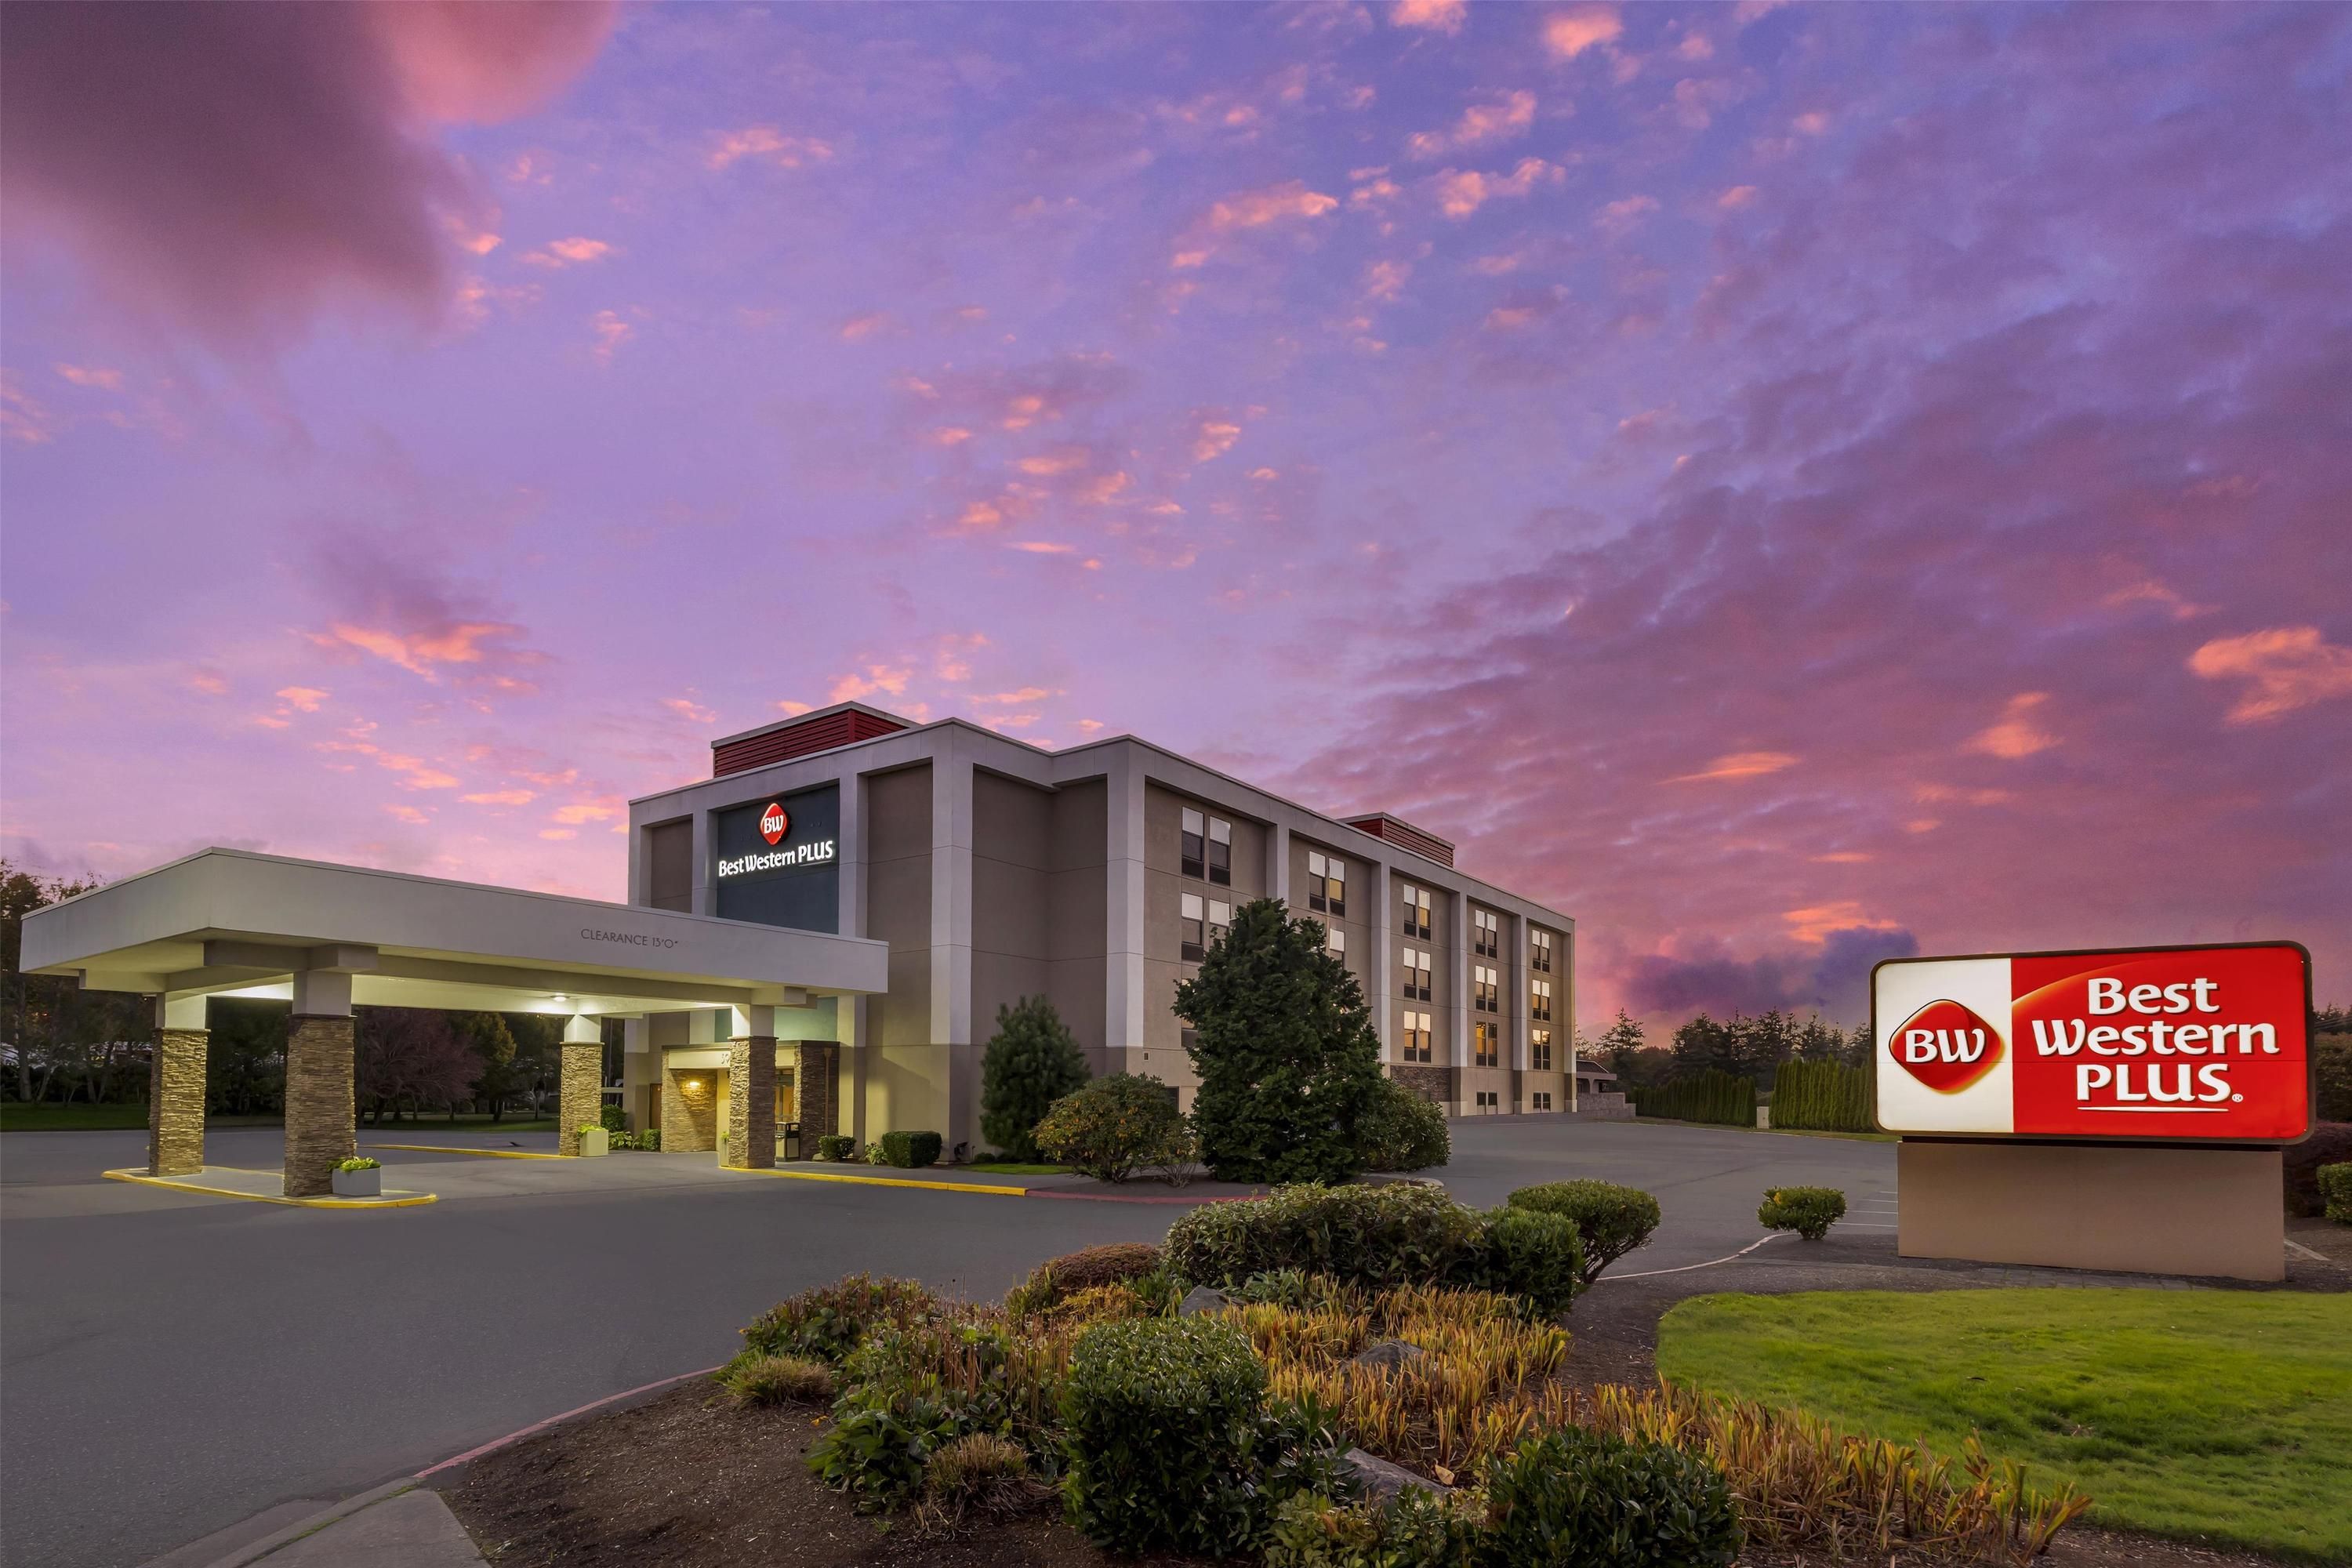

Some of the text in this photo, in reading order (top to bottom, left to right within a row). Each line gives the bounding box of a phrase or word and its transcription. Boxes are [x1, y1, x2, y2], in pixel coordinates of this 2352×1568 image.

[764, 815, 784, 834] BW
[718, 840, 833, 877] Best Western PLUS
[580, 928, 648, 946] CLEARANCE
[2088, 978, 2220, 1014] Best
[1905, 1028, 1985, 1063] BW
[2031, 1019, 2280, 1056] Western
